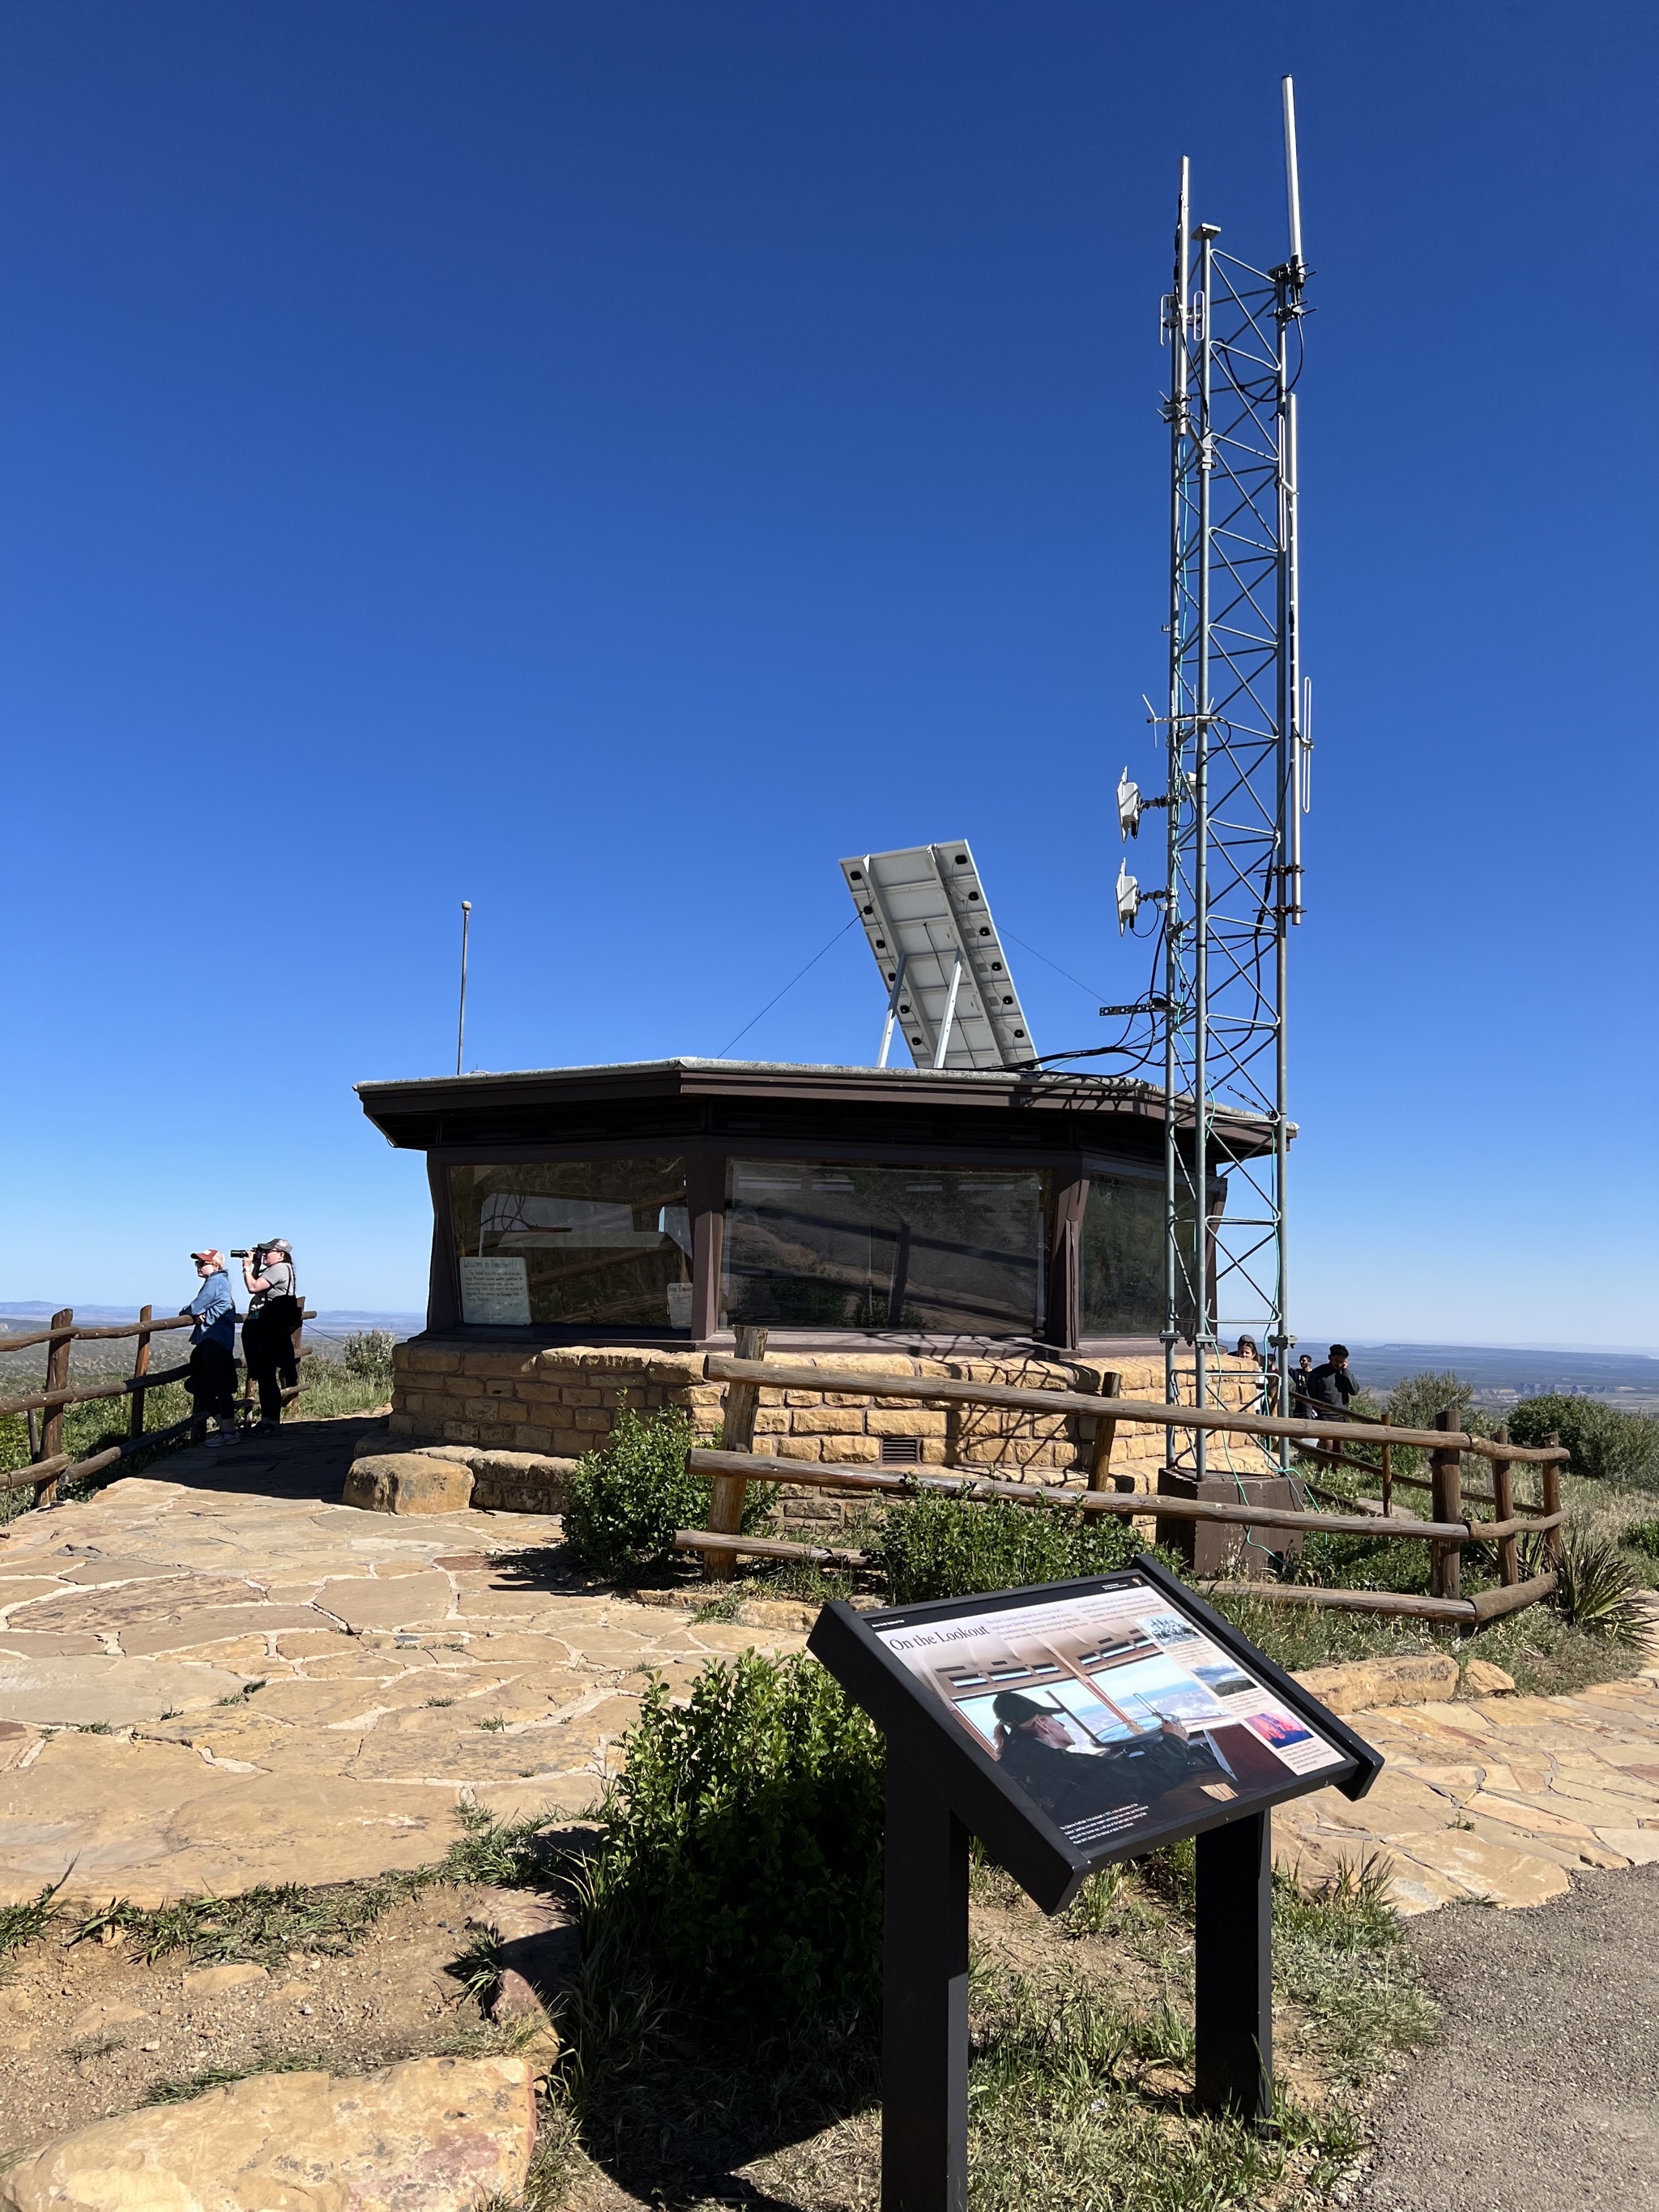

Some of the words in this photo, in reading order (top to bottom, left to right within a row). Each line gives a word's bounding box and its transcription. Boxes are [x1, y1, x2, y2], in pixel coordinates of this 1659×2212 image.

[463, 1259, 483, 1268] WELCOME
[889, 1640, 914, 1650] On
[913, 1635, 937, 1646] the
[934, 1625, 990, 1642] Lookout
